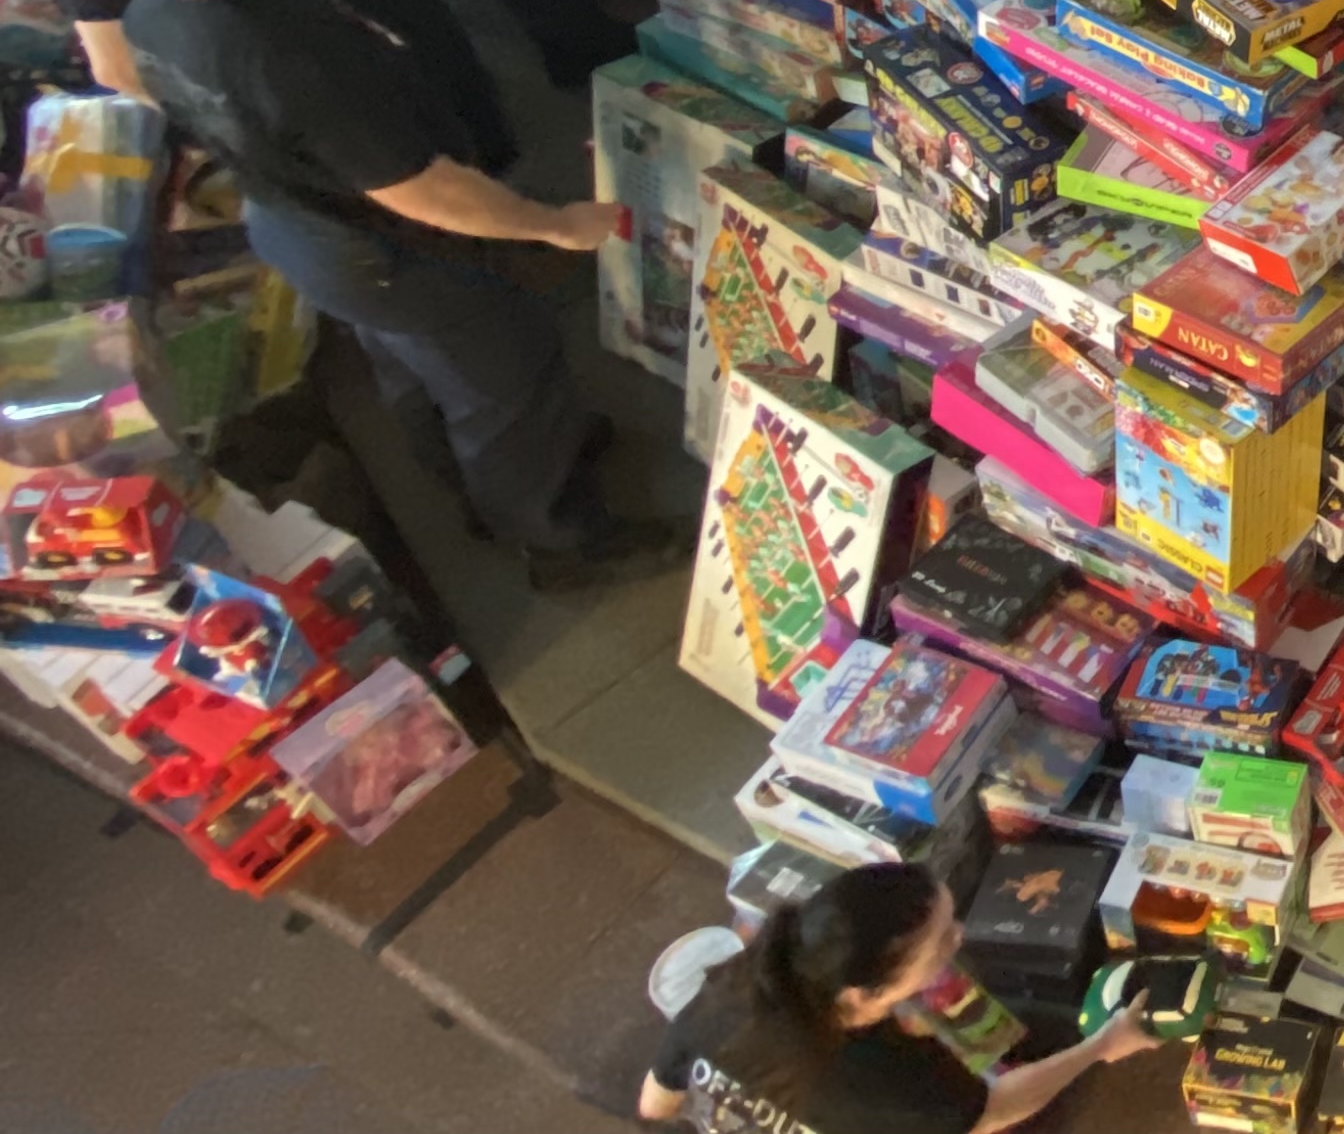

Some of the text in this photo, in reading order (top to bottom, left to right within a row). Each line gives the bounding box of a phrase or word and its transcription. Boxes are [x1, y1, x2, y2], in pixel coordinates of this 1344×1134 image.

[1090, 25, 1205, 89] Baking Play Set
[1177, 327, 1230, 362] CATAN
[1215, 1047, 1263, 1067] GROWING
[1262, 1053, 1286, 1071] LAB
